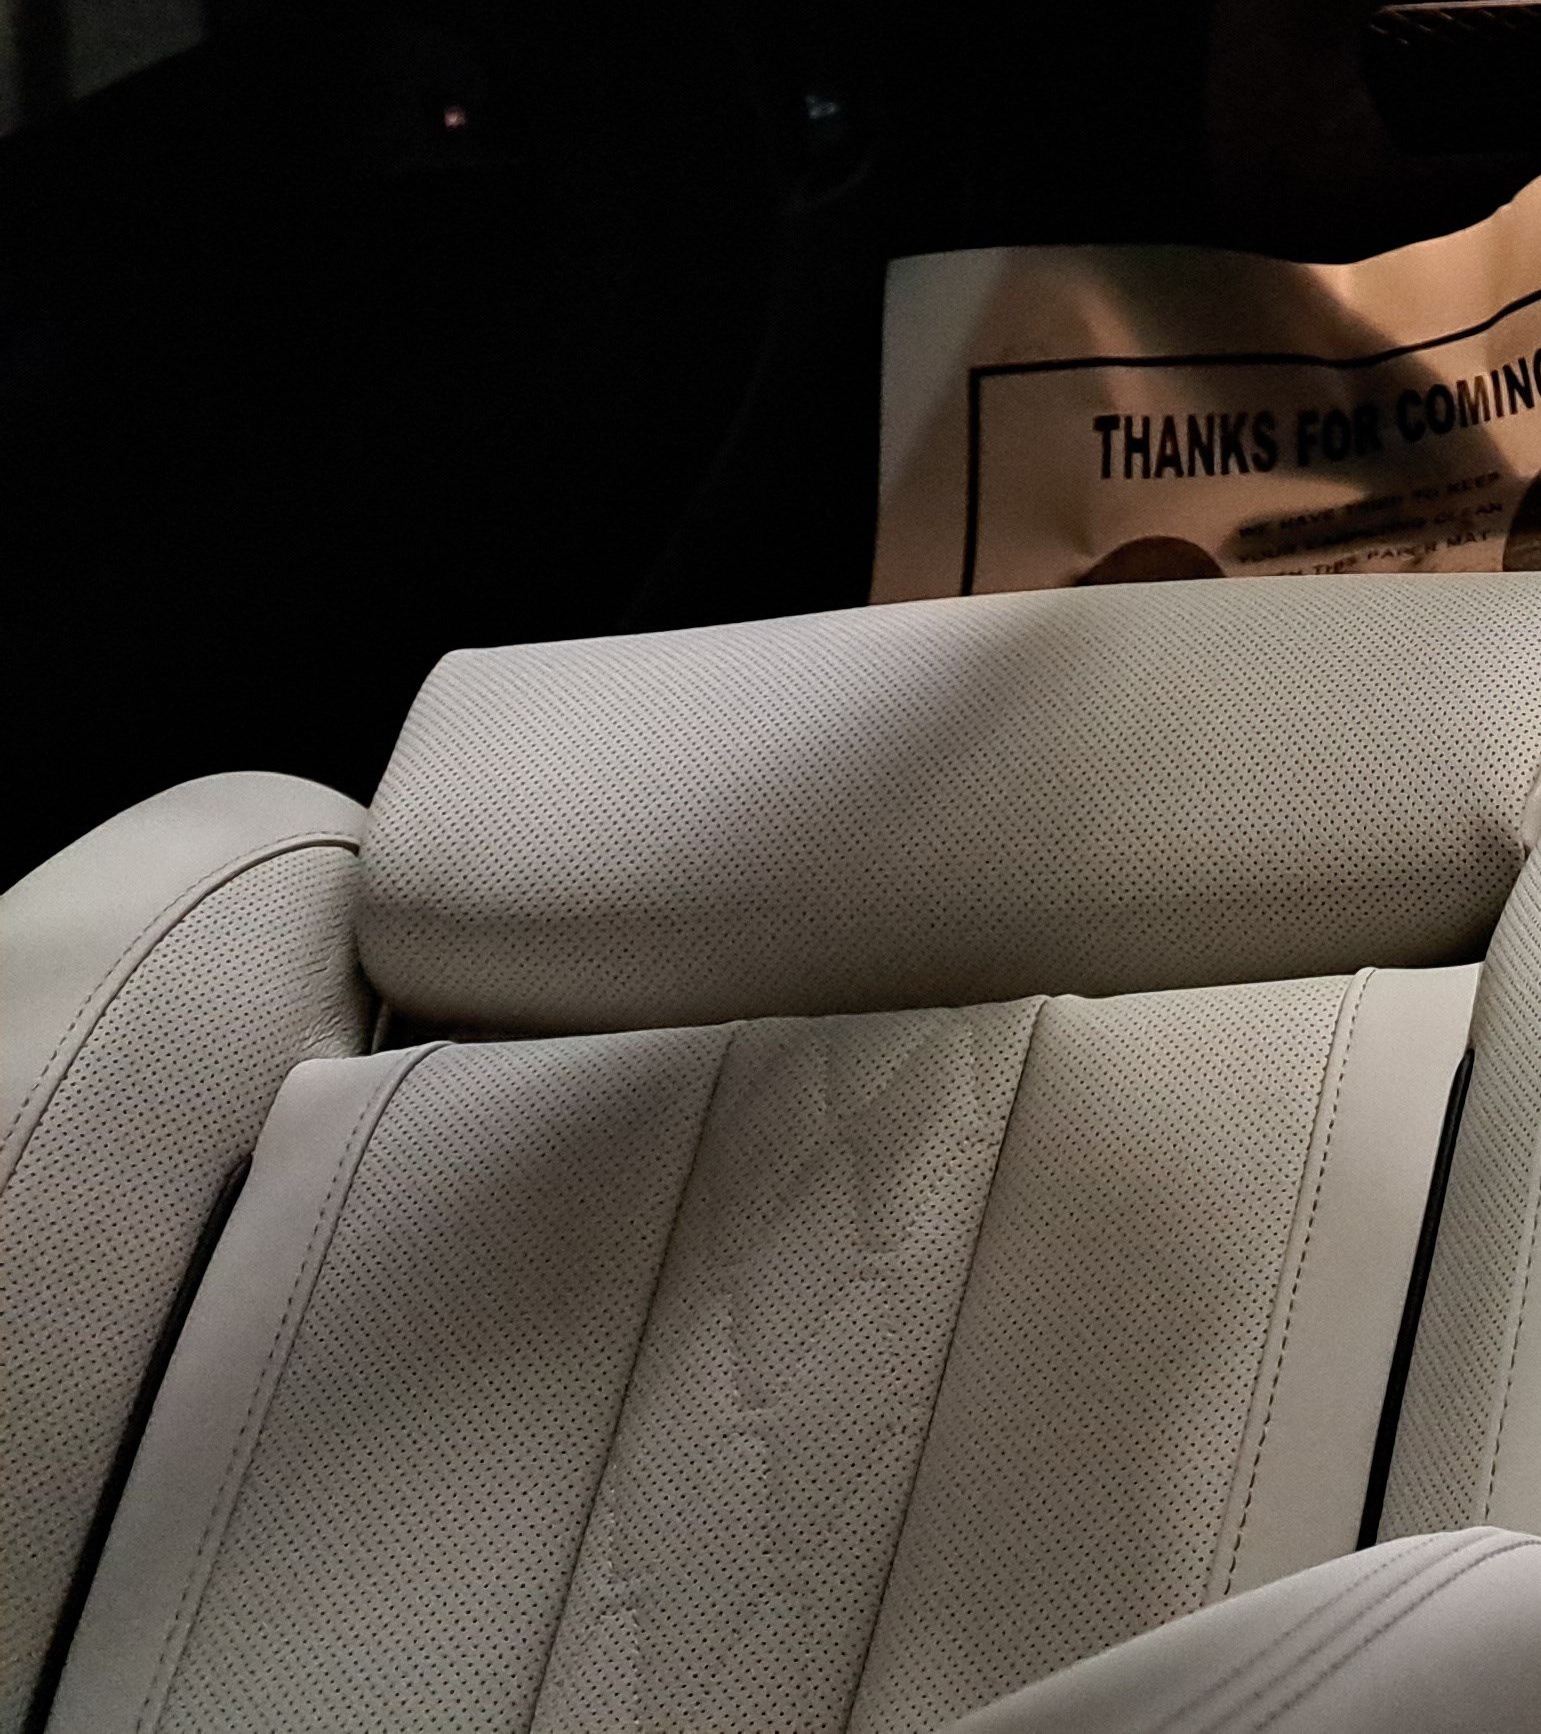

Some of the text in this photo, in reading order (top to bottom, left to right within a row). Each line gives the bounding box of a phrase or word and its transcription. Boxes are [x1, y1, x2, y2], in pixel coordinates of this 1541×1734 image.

[1093, 410, 1279, 480] THANKS
[1296, 402, 1384, 468] FOR
[1447, 529, 1490, 547] MAT
